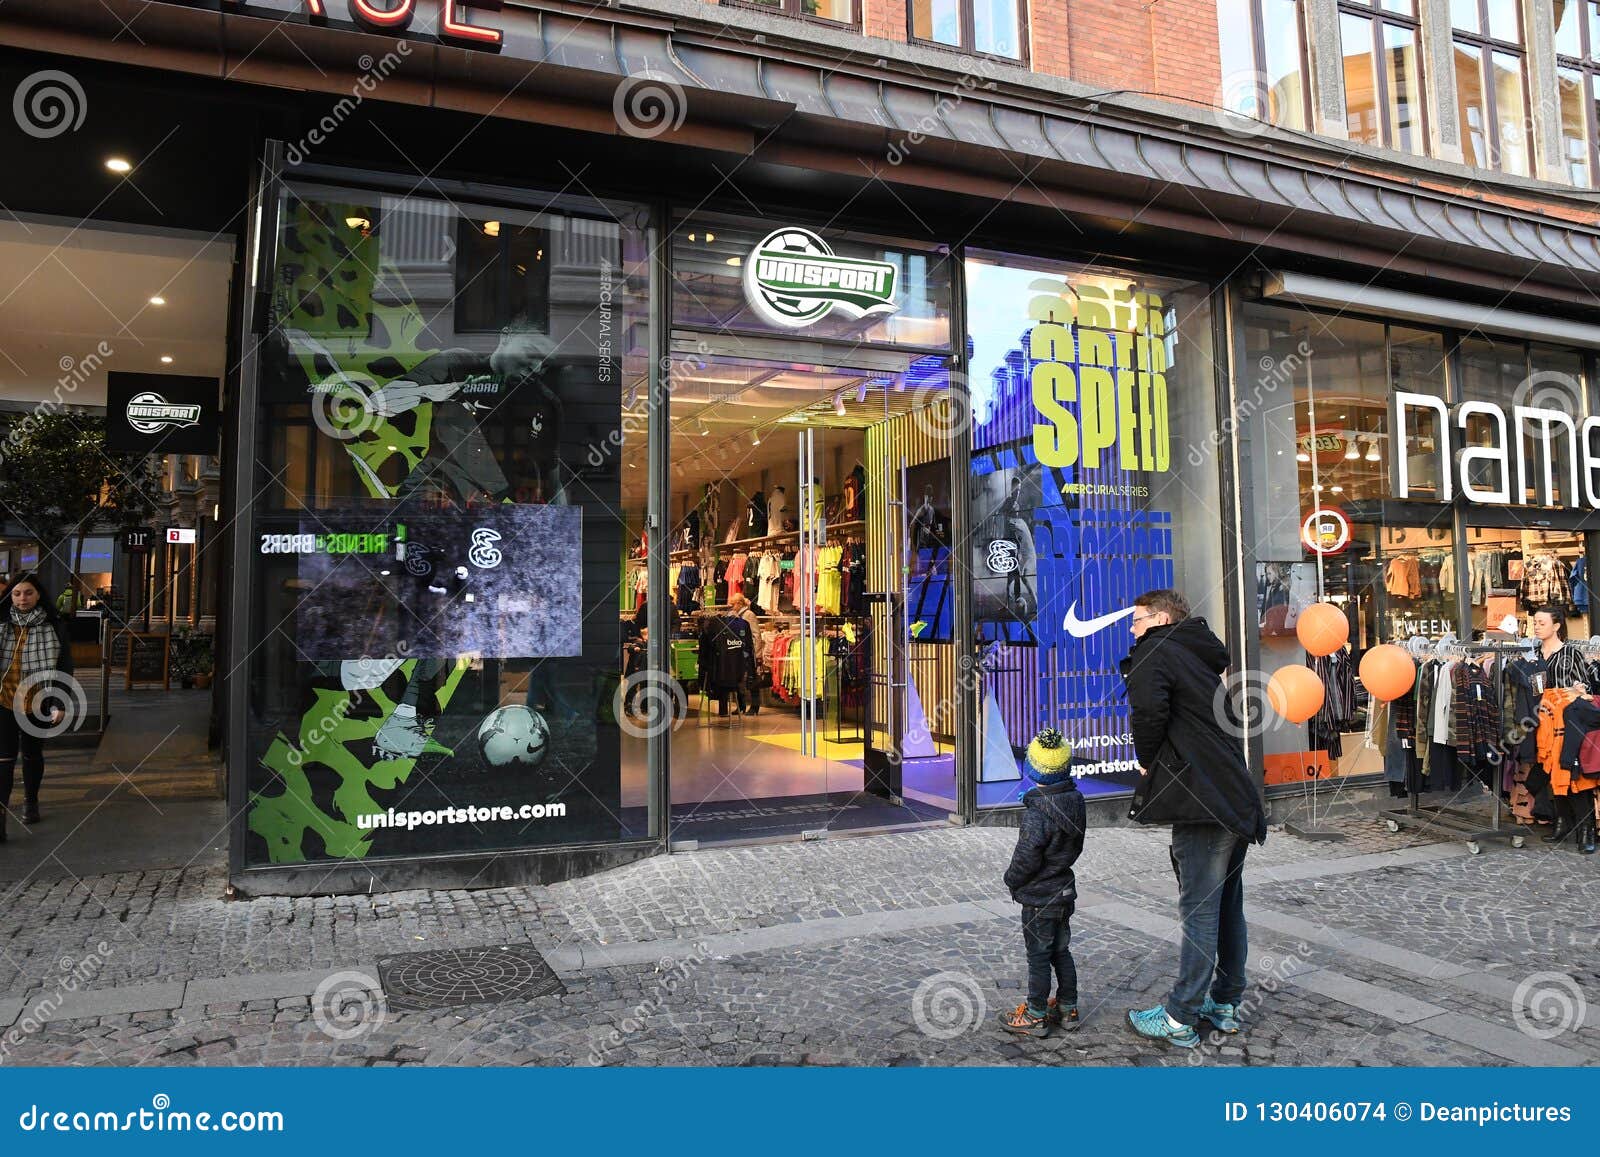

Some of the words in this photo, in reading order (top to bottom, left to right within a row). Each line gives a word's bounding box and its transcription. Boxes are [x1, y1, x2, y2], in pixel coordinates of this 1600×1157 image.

[758, 257, 892, 293] UNISPORT
[128, 405, 199, 419] UNISPORT
[1031, 362, 1170, 473] SPEED
[1065, 733, 1135, 750] HANTOMSE
[1069, 758, 1141, 780] sportstore
[356, 802, 566, 831] unisportstore.com
